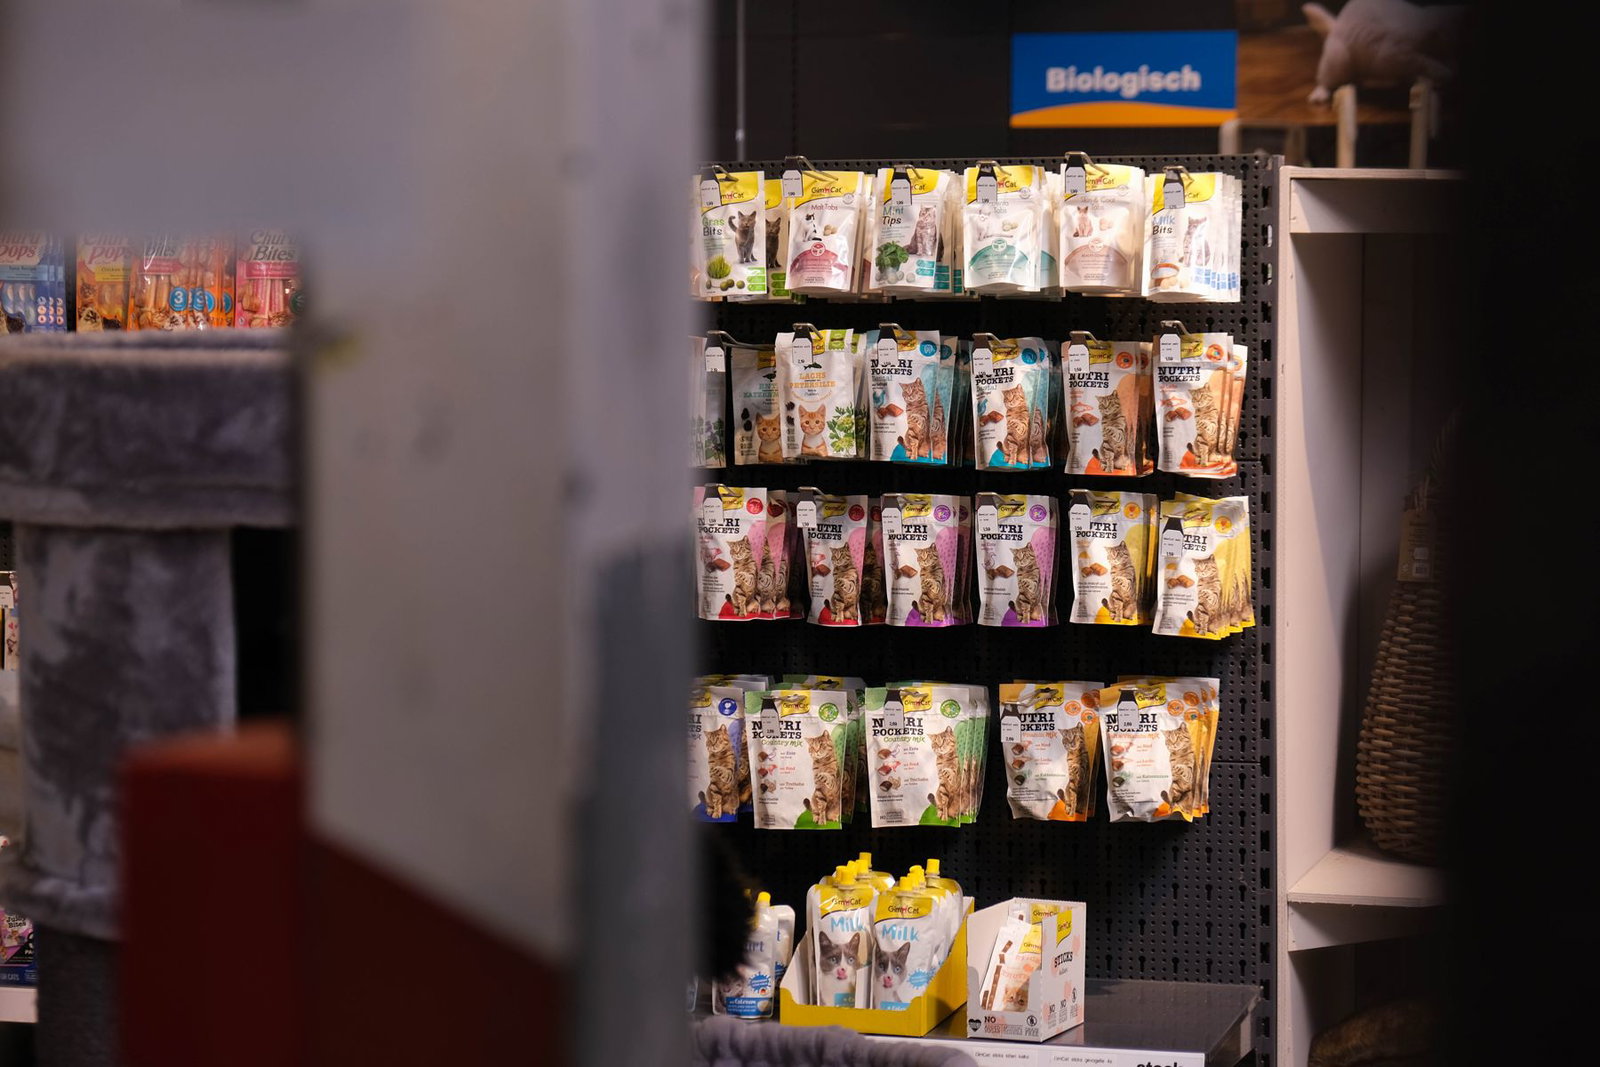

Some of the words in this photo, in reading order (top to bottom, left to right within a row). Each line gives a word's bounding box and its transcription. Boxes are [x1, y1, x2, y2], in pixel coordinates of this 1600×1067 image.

[1046, 64, 1201, 99] Biologisch
[702, 217, 725, 227] Gras
[882, 216, 902, 226] Tips
[703, 227, 723, 237] Bits
[1152, 226, 1173, 236] Bits
[254, 245, 296, 261] Bites
[174, 290, 184, 304] 3
[871, 359, 914, 368] NRI
[871, 368, 913, 376] POCKETS
[1158, 366, 1201, 375] NUTRI
[976, 376, 1014, 386] POCKETS
[1069, 372, 1109, 381] NUTRI
[698, 518, 740, 527] NRI
[698, 526, 740, 534] POCKETS
[902, 524, 928, 534] TRI
[998, 524, 1023, 534] TRI
[981, 533, 1023, 541] POCKETS
[1076, 531, 1117, 539] POCKETS
[1183, 534, 1208, 545] TRI
[1182, 542, 1207, 552] KETS
[872, 717, 923, 728] NRI
[1020, 712, 1055, 723] UTRI
[1106, 714, 1157, 724] NRI
[752, 721, 802, 731] NRI
[1020, 723, 1055, 731] CKETS
[872, 728, 924, 736] POCKETS
[882, 924, 919, 942] Milk
[1054, 951, 1073, 968] STICKS
[985, 1016, 997, 1024] NO
